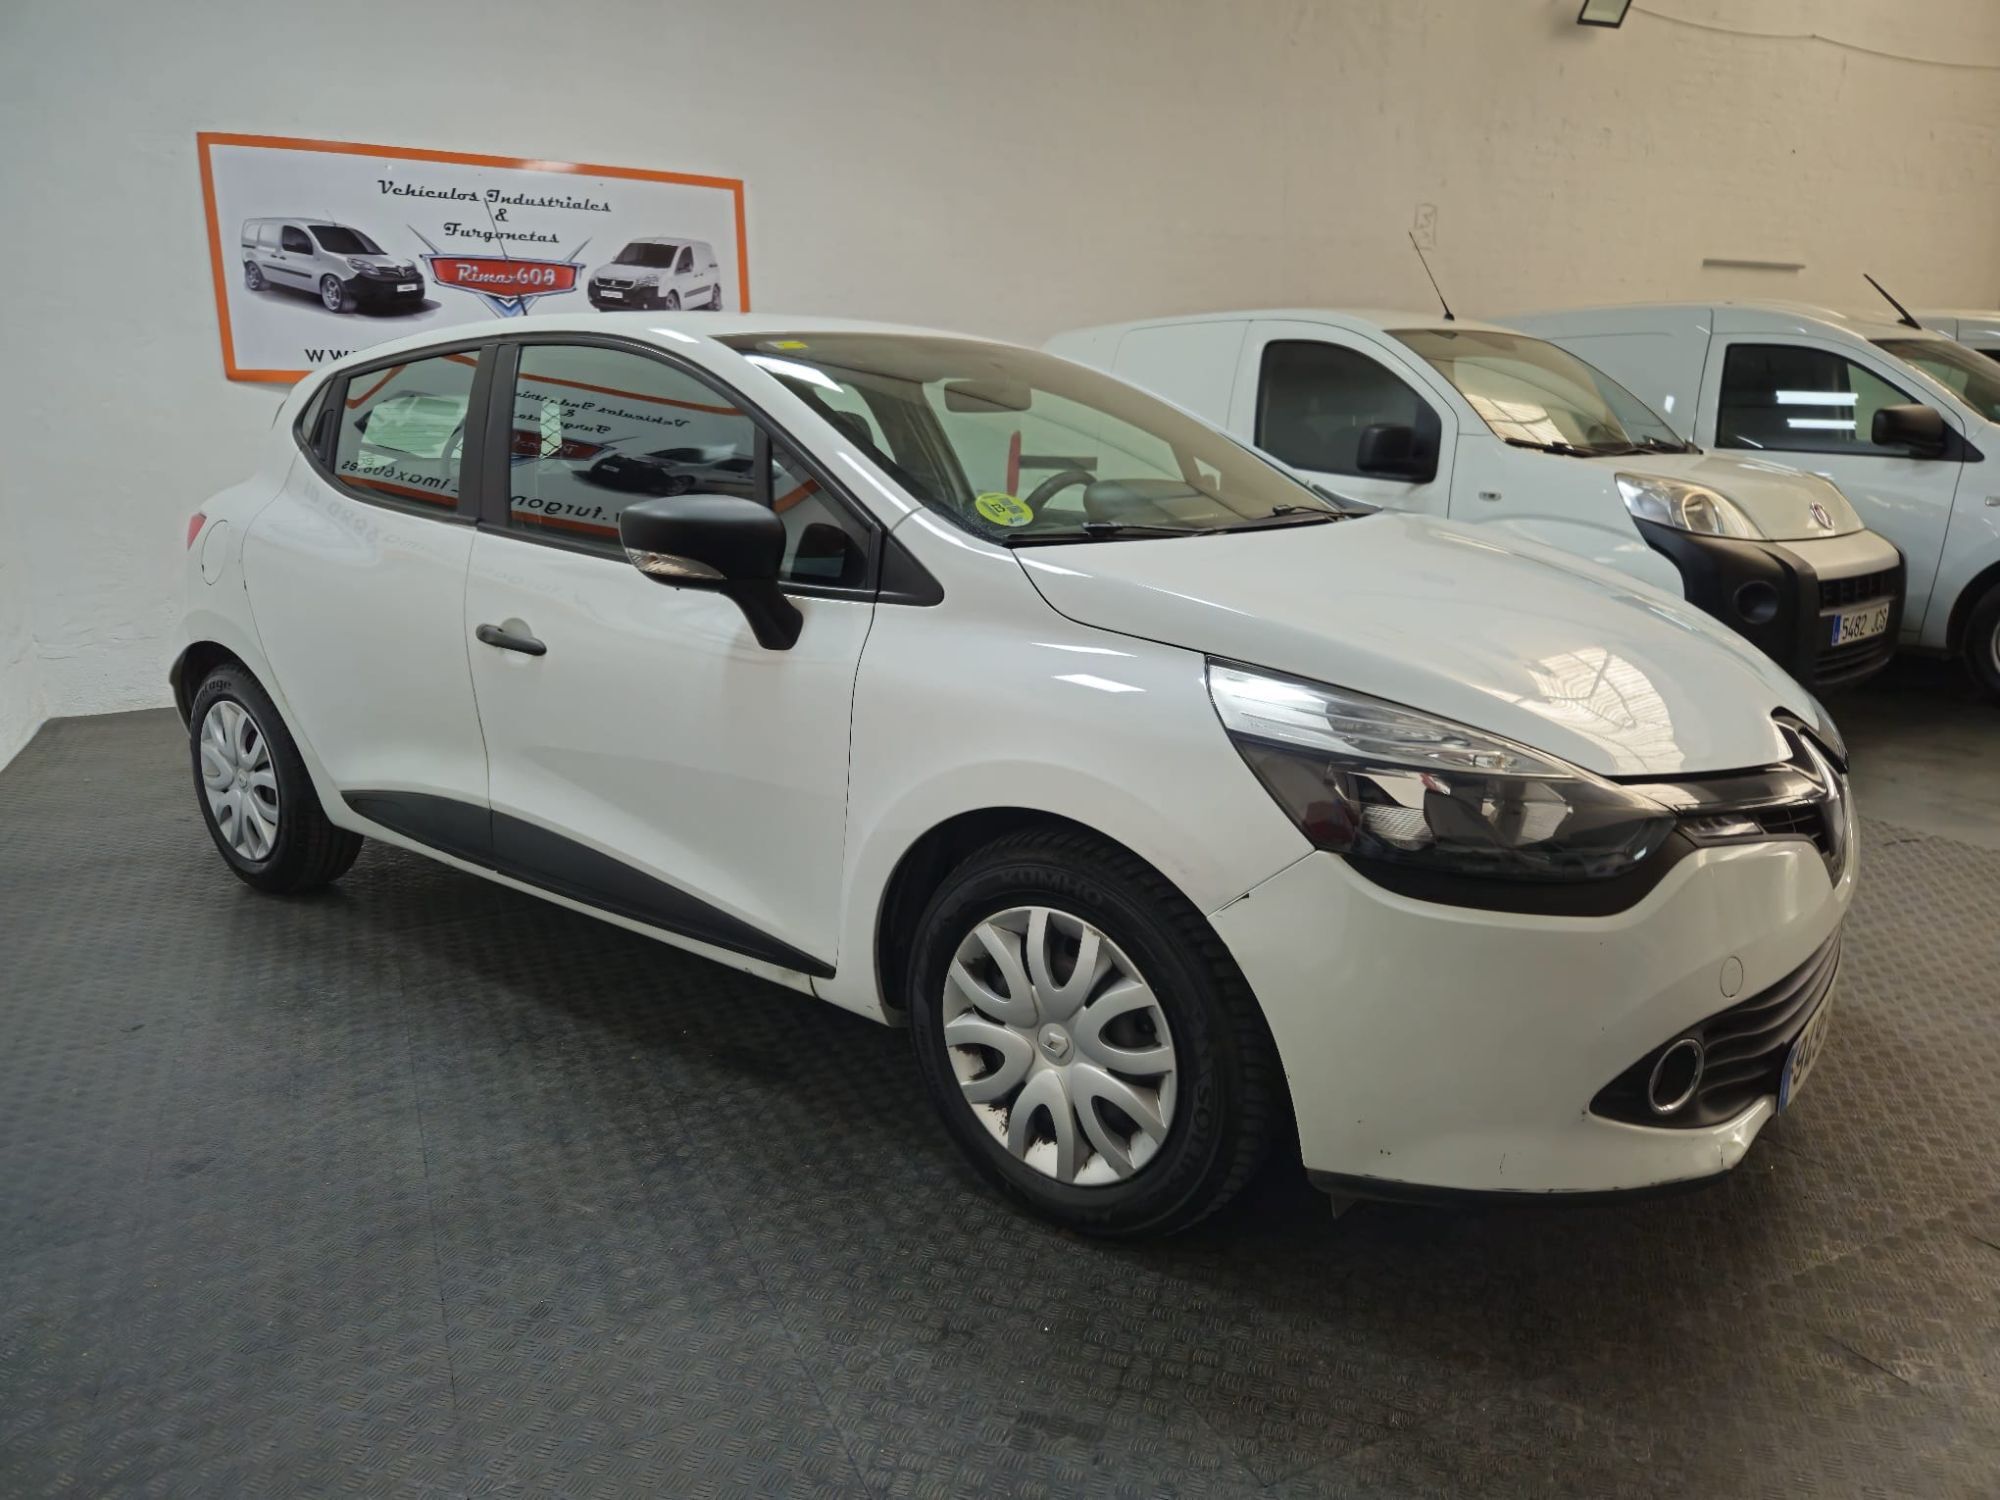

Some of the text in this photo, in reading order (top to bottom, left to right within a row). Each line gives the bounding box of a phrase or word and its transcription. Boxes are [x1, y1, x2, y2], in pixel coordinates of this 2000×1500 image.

[486, 189, 612, 212] Industriales
[495, 208, 509, 222] &
[443, 222, 560, 243] Furgonetas
[1842, 613, 1867, 640] 5482
